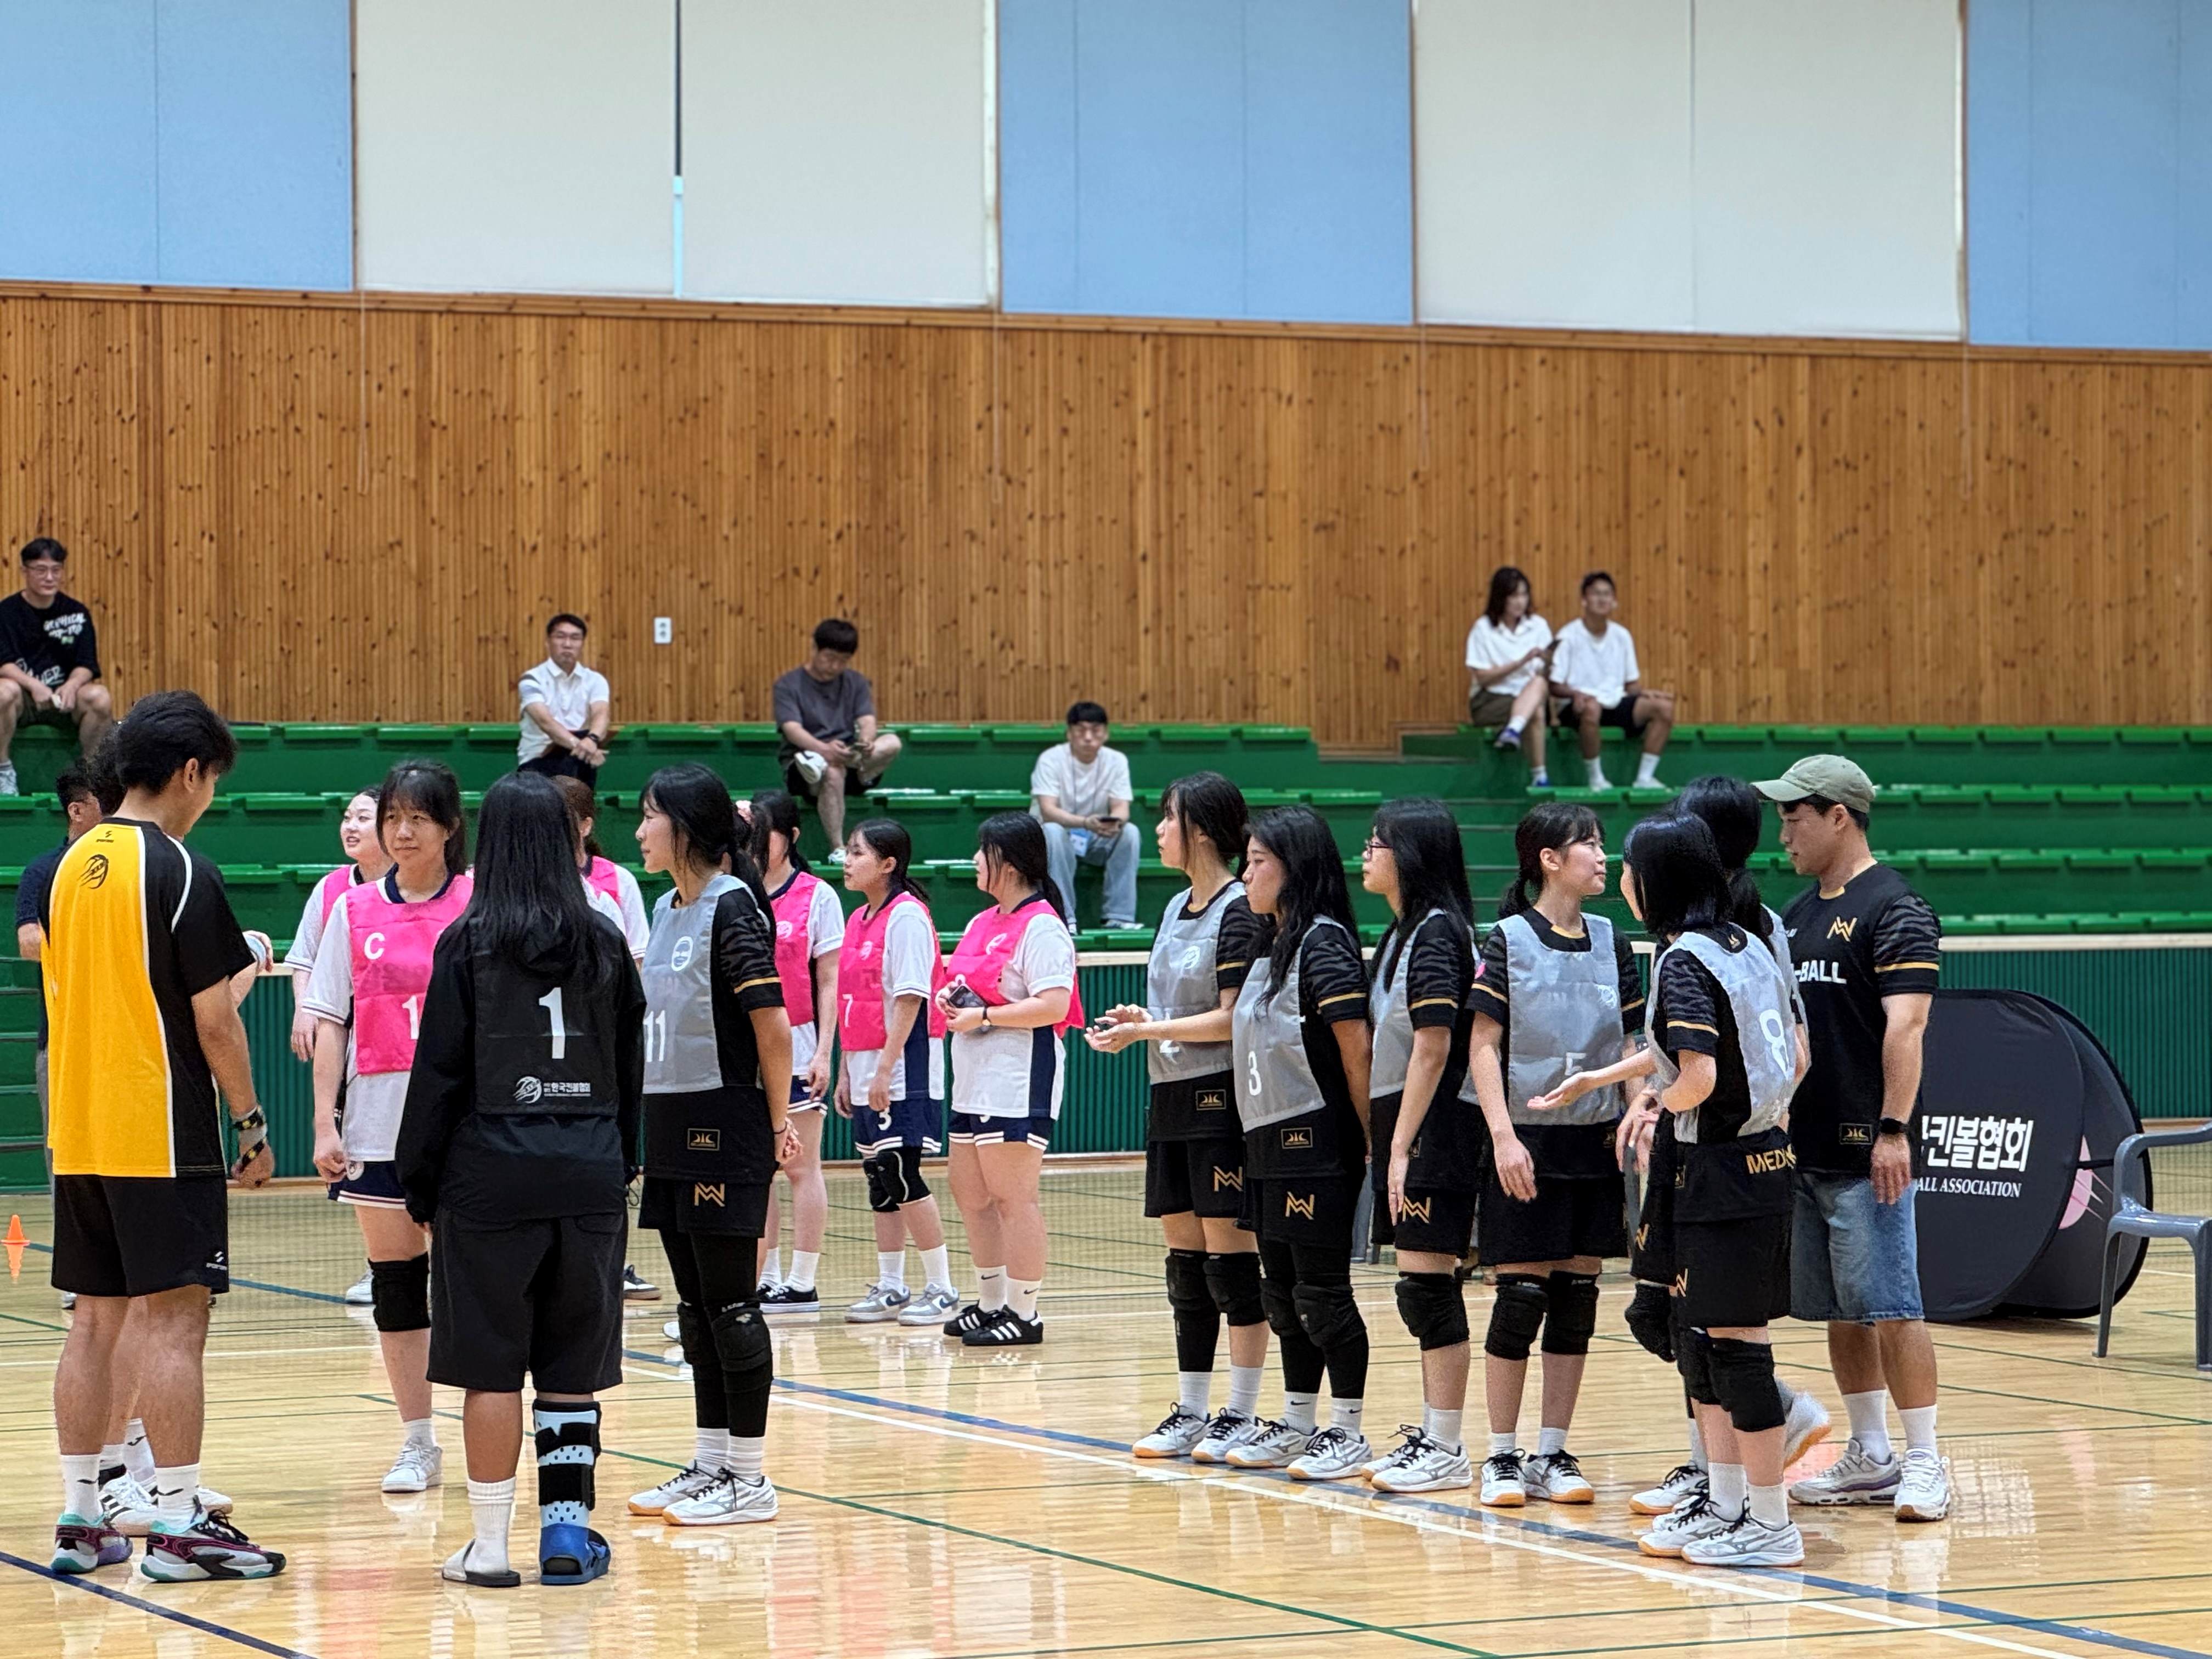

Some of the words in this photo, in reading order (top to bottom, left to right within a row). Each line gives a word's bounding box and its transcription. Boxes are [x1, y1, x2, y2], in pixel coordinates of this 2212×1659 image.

[364, 933, 385, 960] C
[1791, 960, 1847, 984] -BALL
[402, 995, 420, 1040] 1
[539, 987, 565, 1059] 1
[843, 994, 853, 1028] 7
[642, 1010, 665, 1062] 11
[1759, 1009, 1790, 1080] 8
[1248, 1051, 1262, 1096] 3
[1746, 1144, 1797, 1174] MED
[1939, 1178, 2022, 1198] ASSOCIATION
